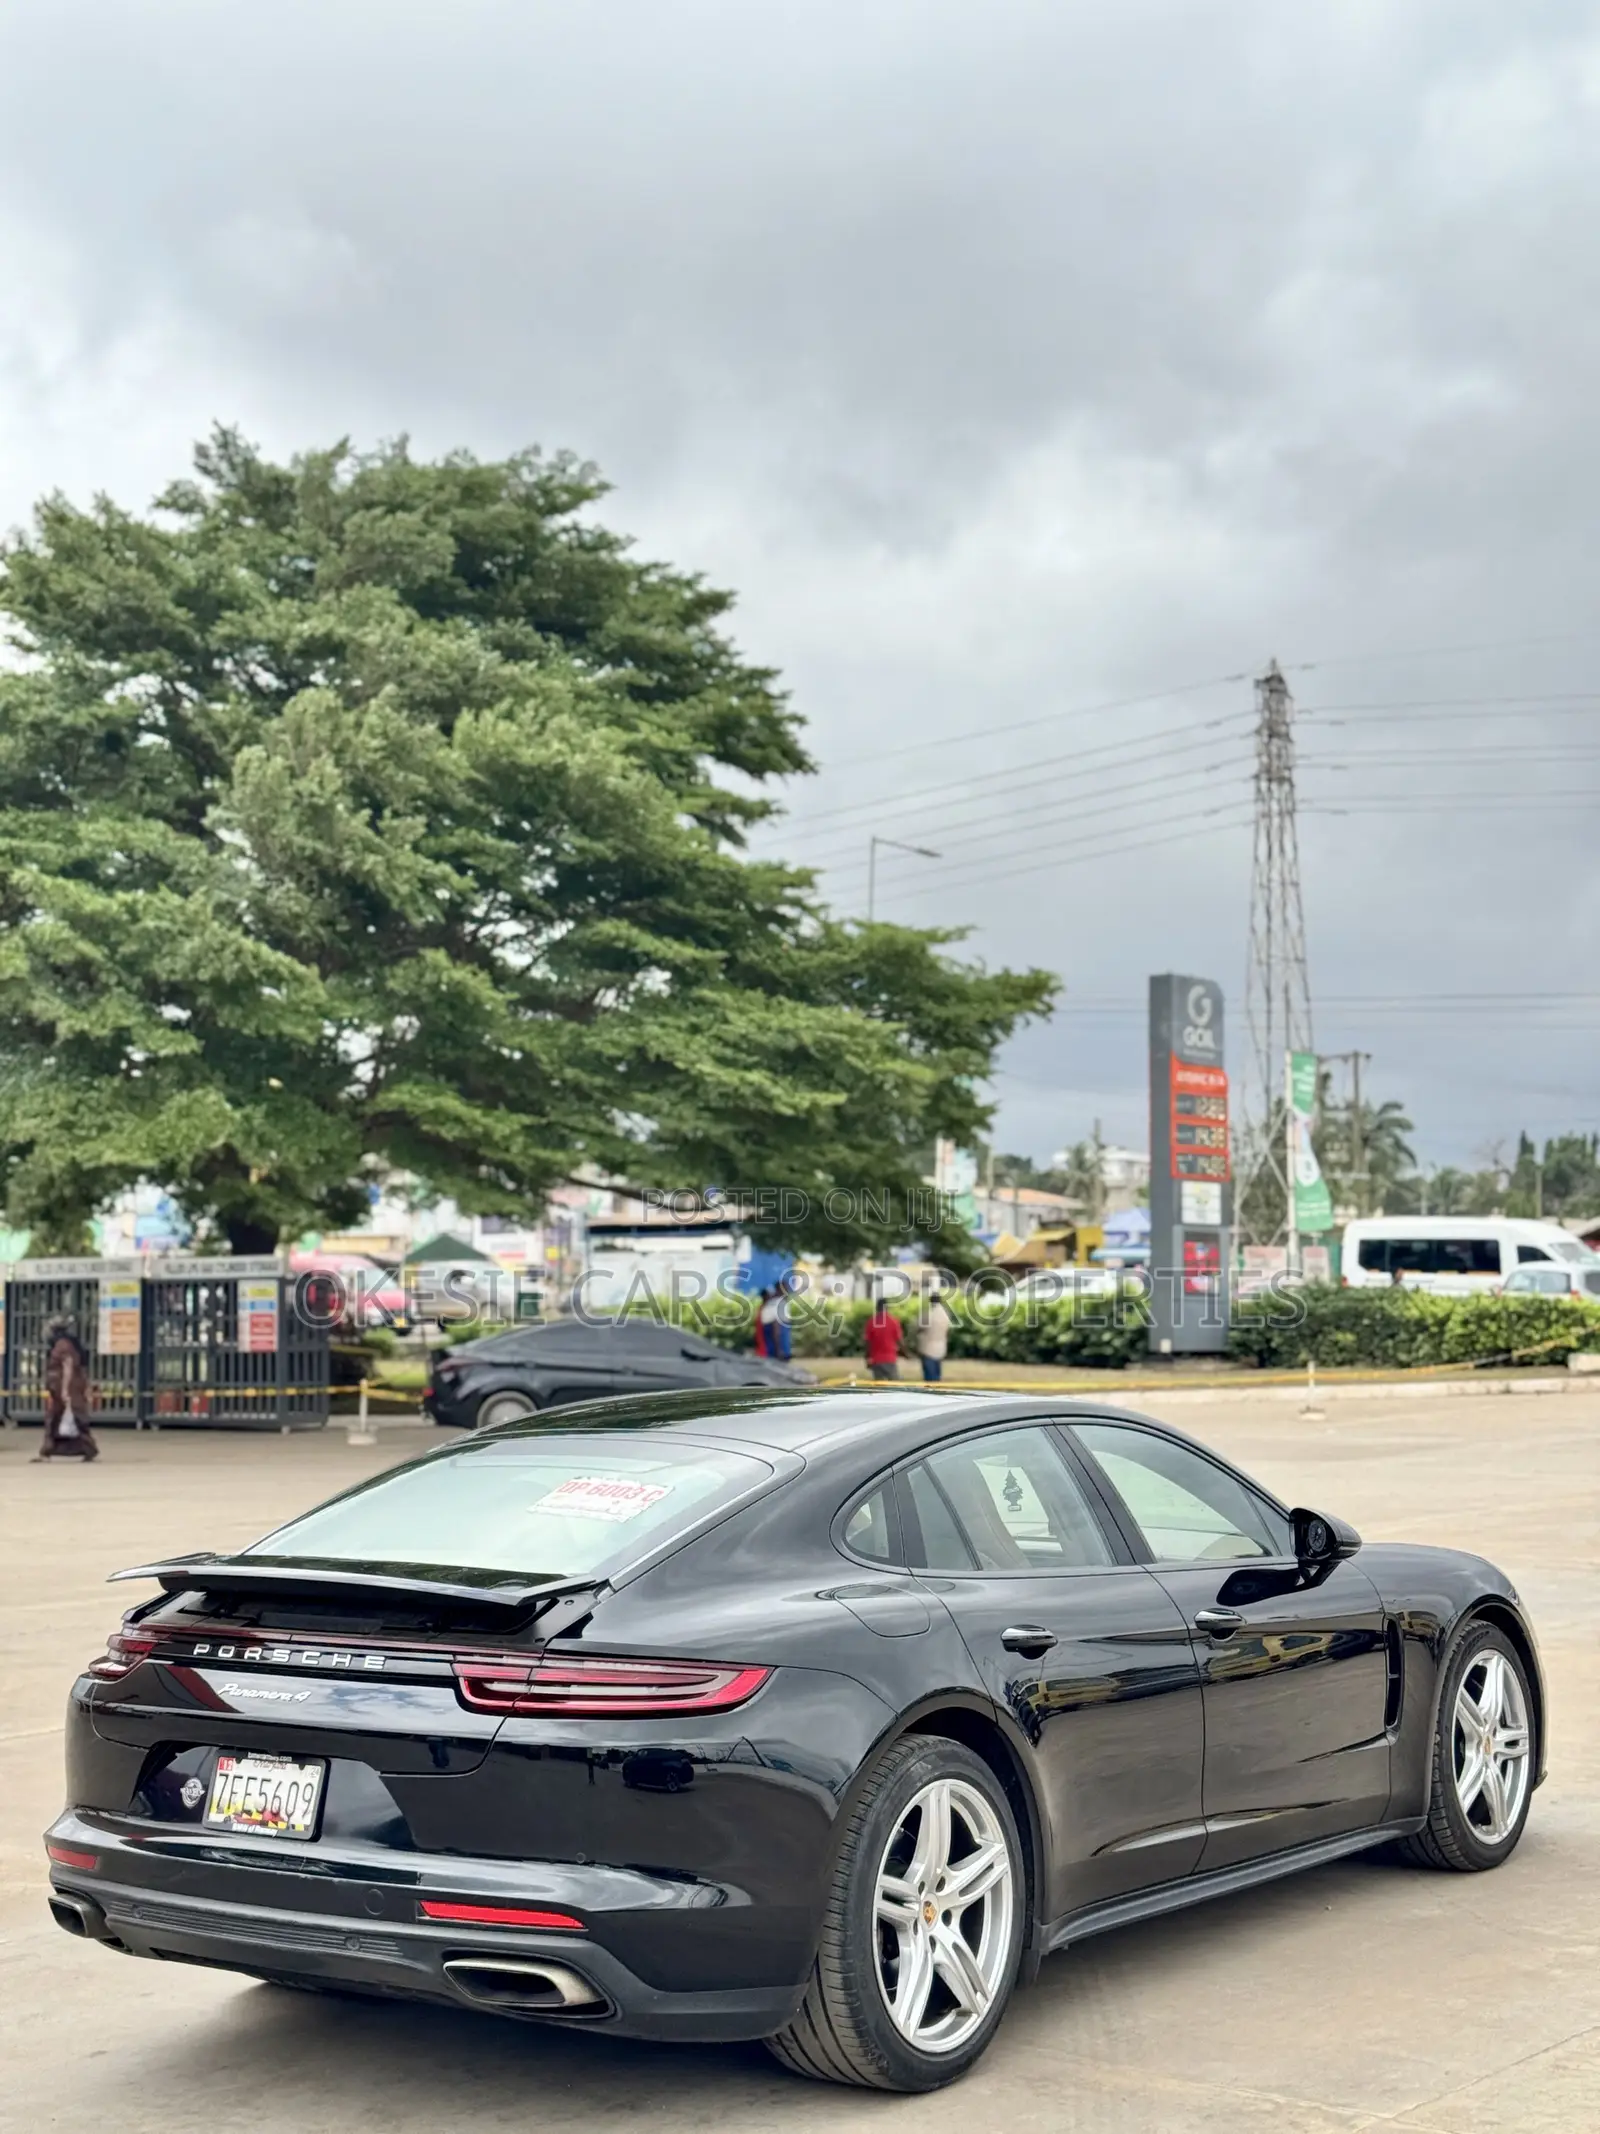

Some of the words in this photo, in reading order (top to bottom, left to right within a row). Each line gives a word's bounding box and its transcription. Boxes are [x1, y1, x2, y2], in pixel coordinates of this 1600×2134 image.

[193, 1643, 385, 1670] PORSCHE
[218, 1683, 291, 1702] Panamera
[291, 1690, 312, 1703] 4
[217, 1773, 314, 1818] 7FE5609
